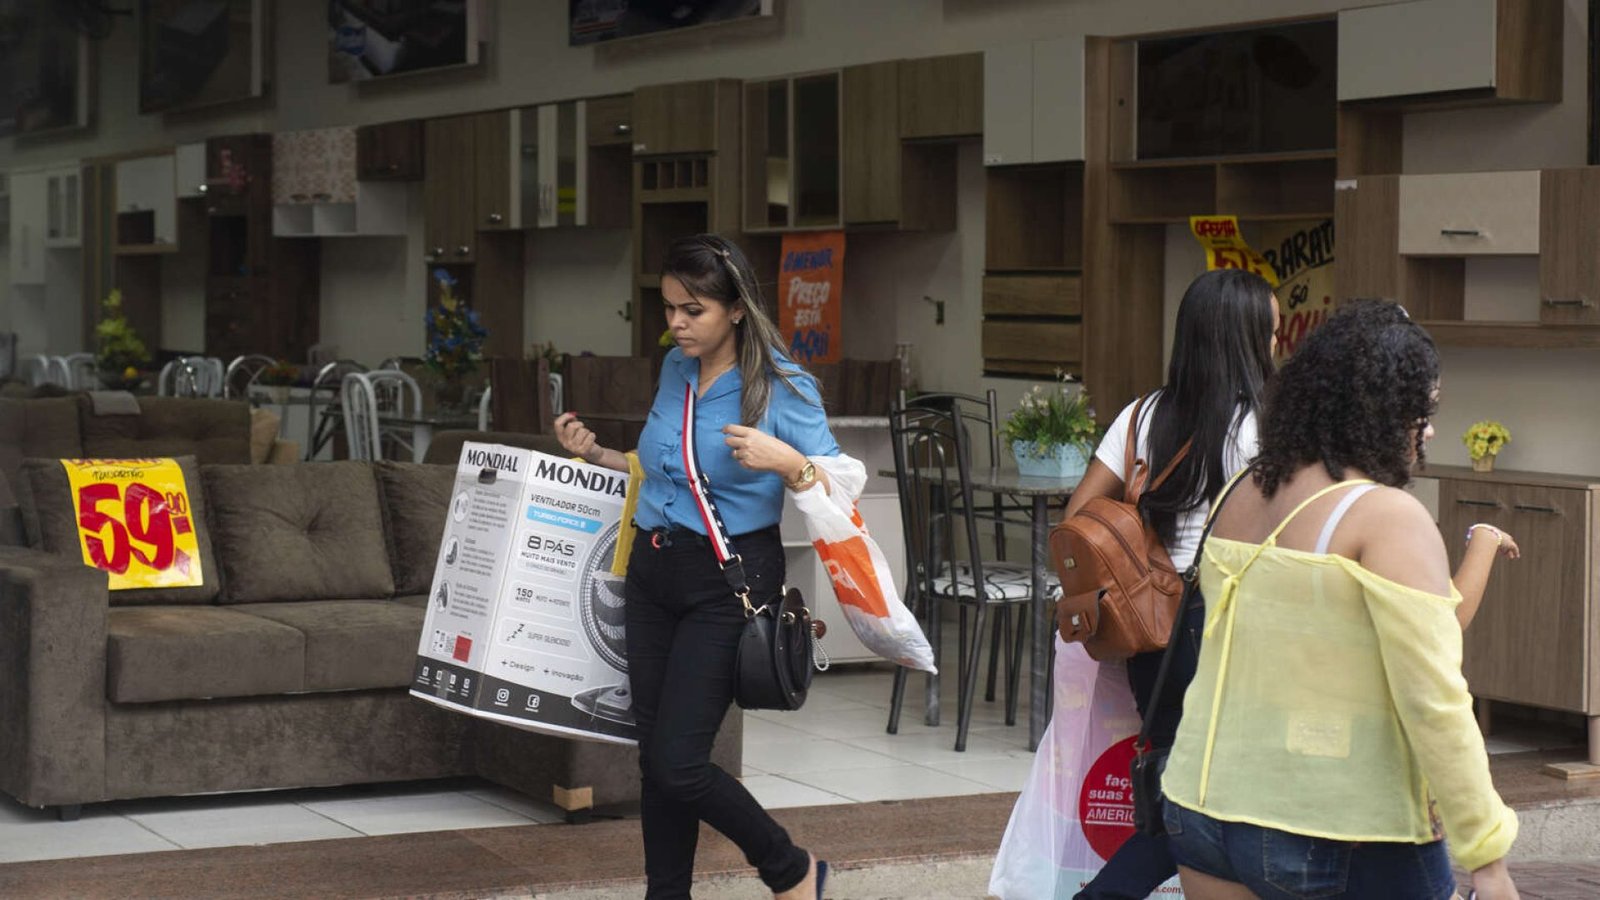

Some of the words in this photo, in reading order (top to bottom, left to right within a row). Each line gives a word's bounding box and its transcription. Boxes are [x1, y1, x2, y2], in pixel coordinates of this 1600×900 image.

[1263, 217, 1335, 280] BARAT
[786, 276, 831, 309] PREÇO
[465, 448, 519, 473] MONDIAL
[534, 458, 627, 499] MONDIA
[531, 493, 577, 511] VENTILADOR
[577, 502, 601, 518] 50cm
[527, 535, 542, 550] 8
[544, 539, 576, 557] PÁS
[521, 551, 540, 561] MUITO
[540, 555, 556, 564] MAIS
[556, 559, 577, 569] VENTO
[516, 587, 533, 598] 150
[509, 660, 535, 672] Design
[1105, 773, 1133, 790] faç
[1088, 789, 1124, 801] suas
